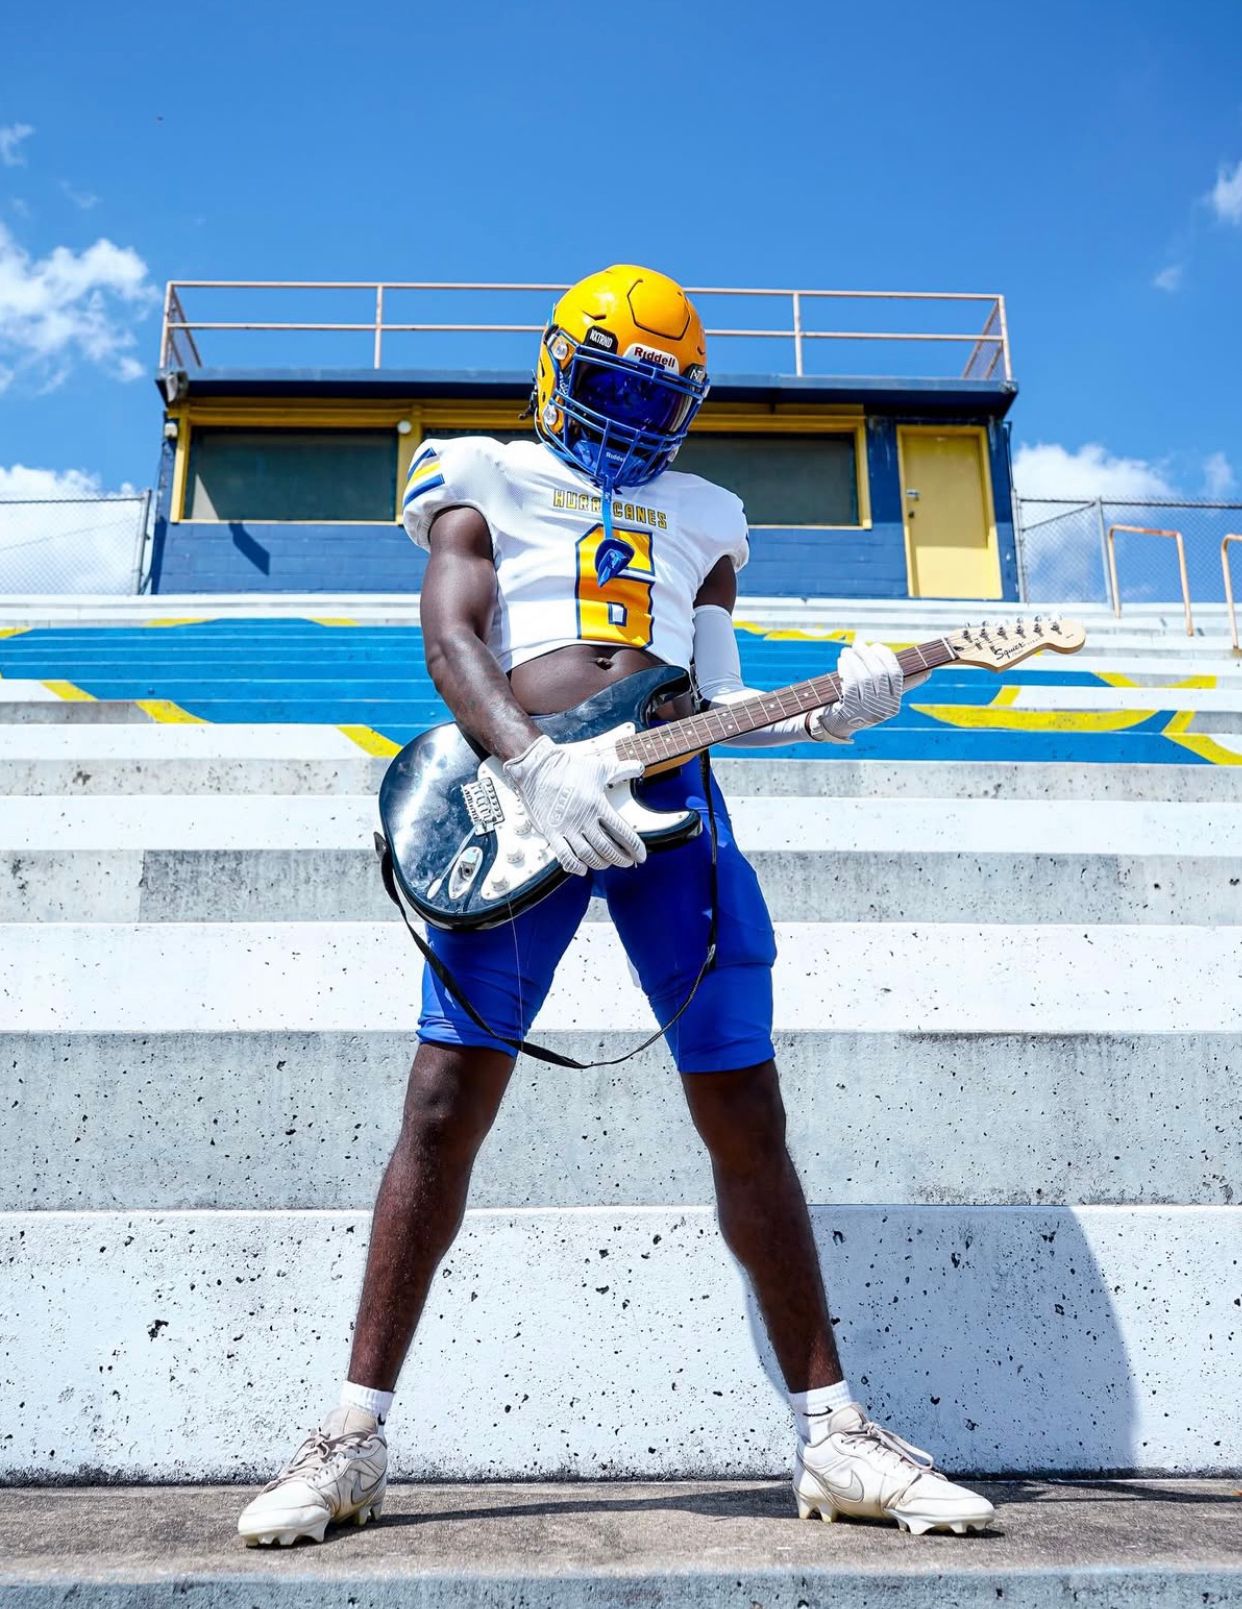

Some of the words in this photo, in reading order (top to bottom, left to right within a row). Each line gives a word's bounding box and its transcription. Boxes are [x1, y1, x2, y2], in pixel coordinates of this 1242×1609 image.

[634, 346, 676, 368] Riddell
[553, 488, 667, 530] HURRCANES
[575, 522, 656, 651] 6
[995, 641, 1025, 660] Squier
